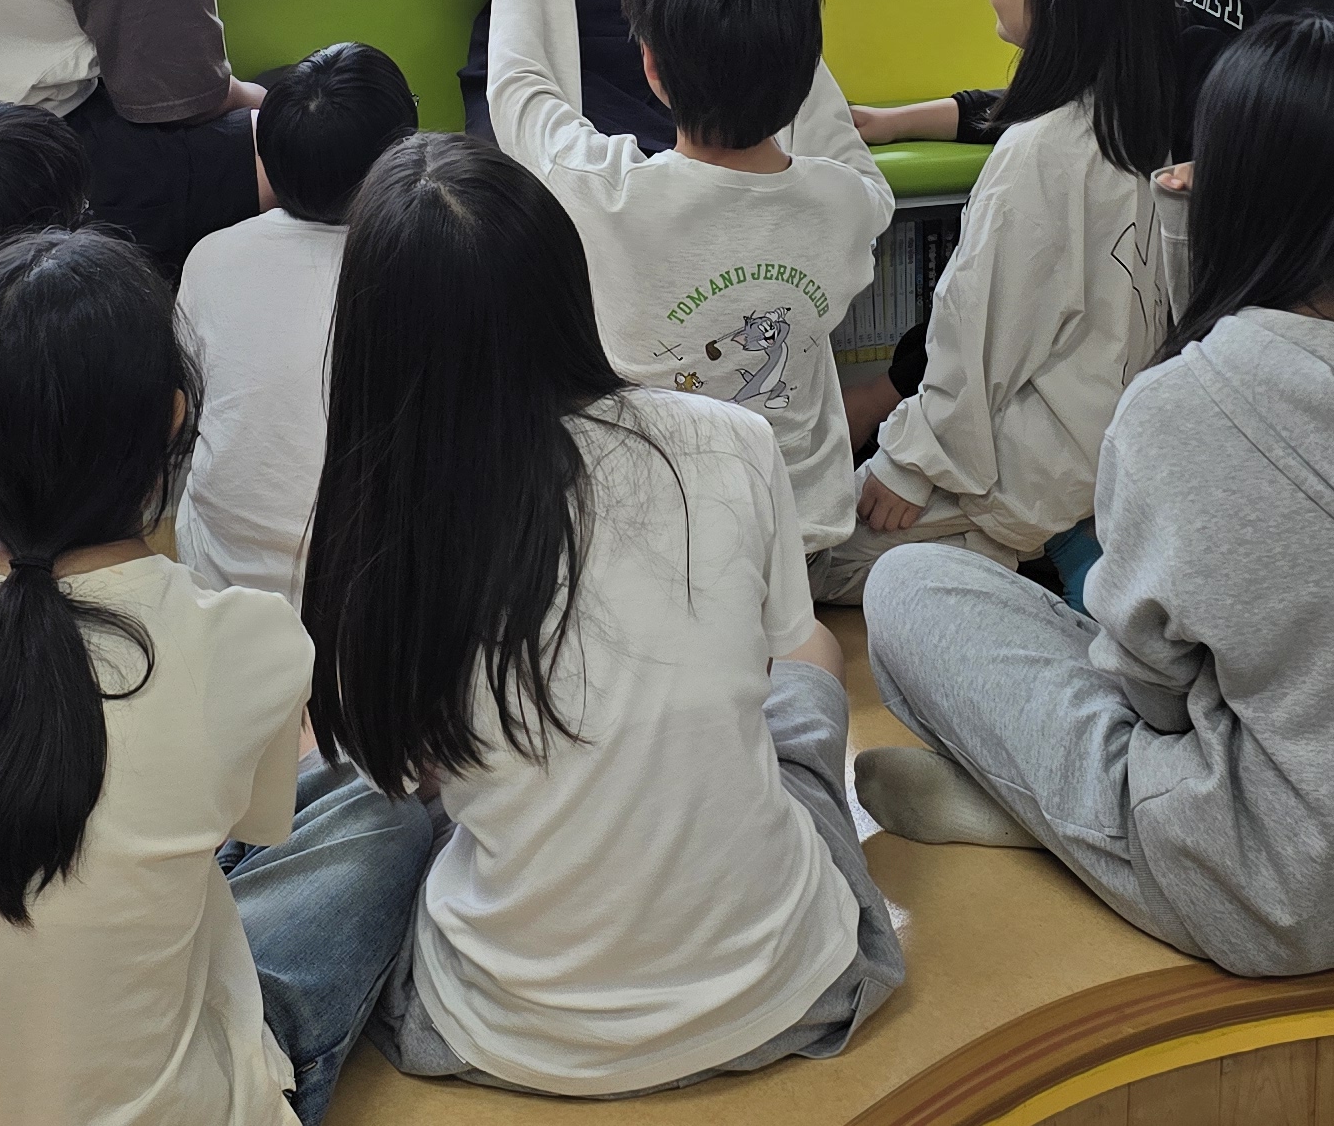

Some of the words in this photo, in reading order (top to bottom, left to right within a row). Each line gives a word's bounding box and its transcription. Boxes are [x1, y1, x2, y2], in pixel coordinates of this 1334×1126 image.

[667, 287, 709, 324] TOM
[708, 265, 747, 297] AND
[750, 263, 807, 289] JERRY
[802, 279, 831, 318] CLUB
